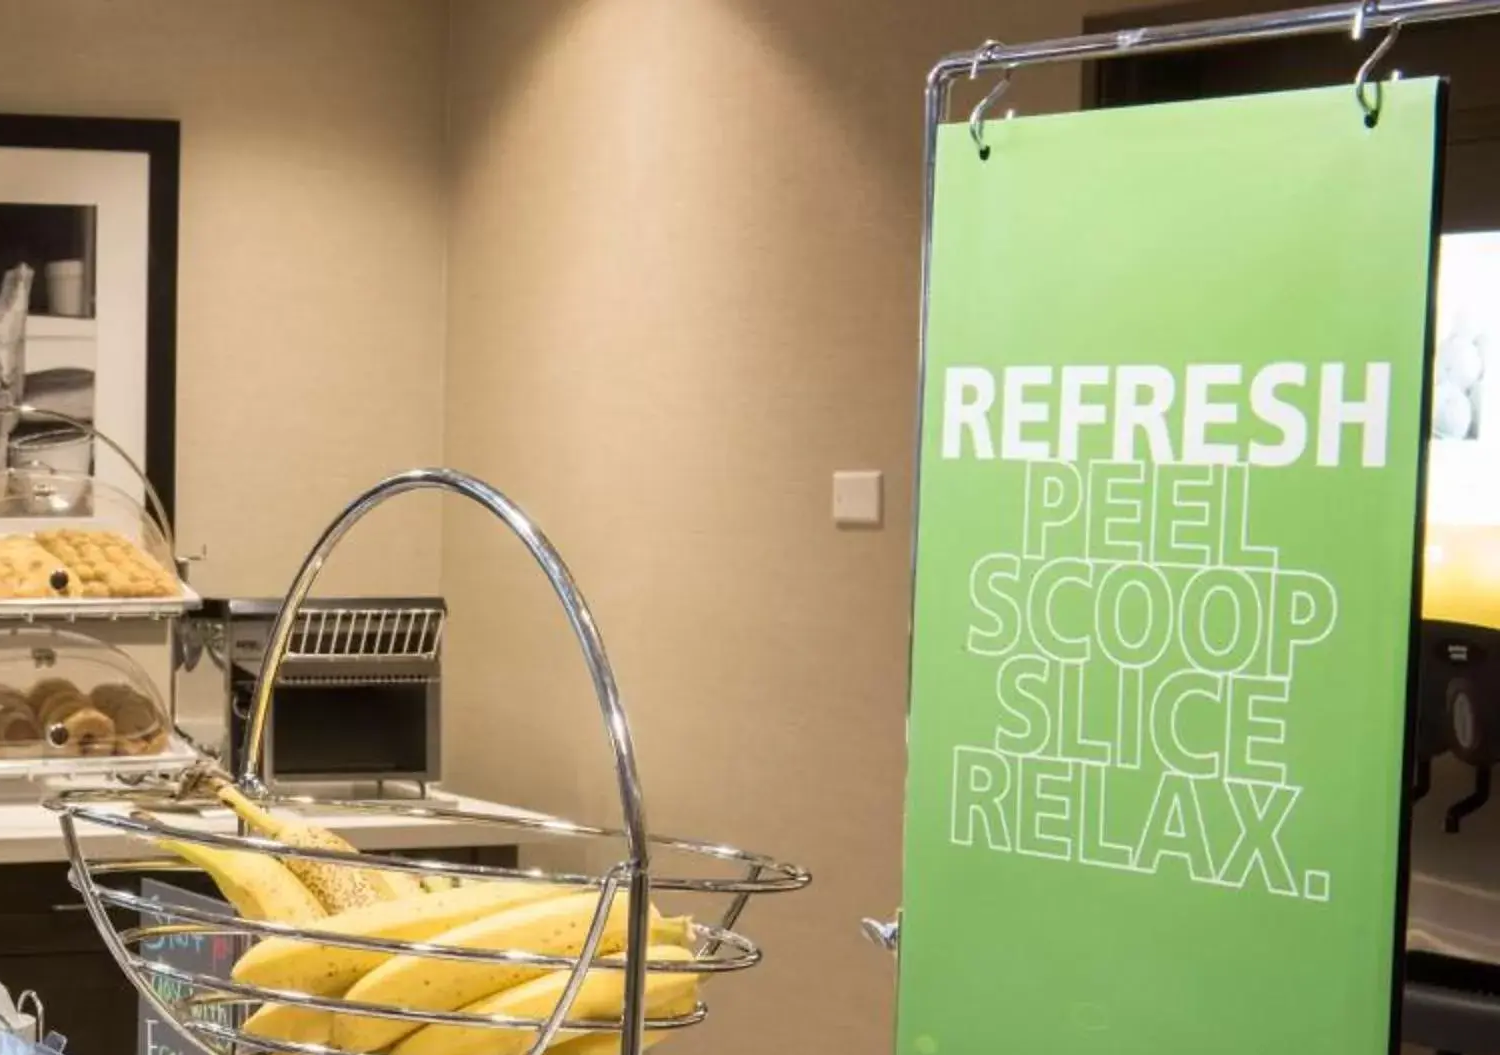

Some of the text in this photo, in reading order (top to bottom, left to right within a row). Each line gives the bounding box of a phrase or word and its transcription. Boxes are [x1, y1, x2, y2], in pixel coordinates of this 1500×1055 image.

[941, 361, 1391, 468] REFRESH
[1023, 458, 1278, 570] PEEL
[967, 553, 1338, 680] SCOOP
[995, 653, 1290, 787] SLICE
[950, 746, 1330, 902] RELAX.
